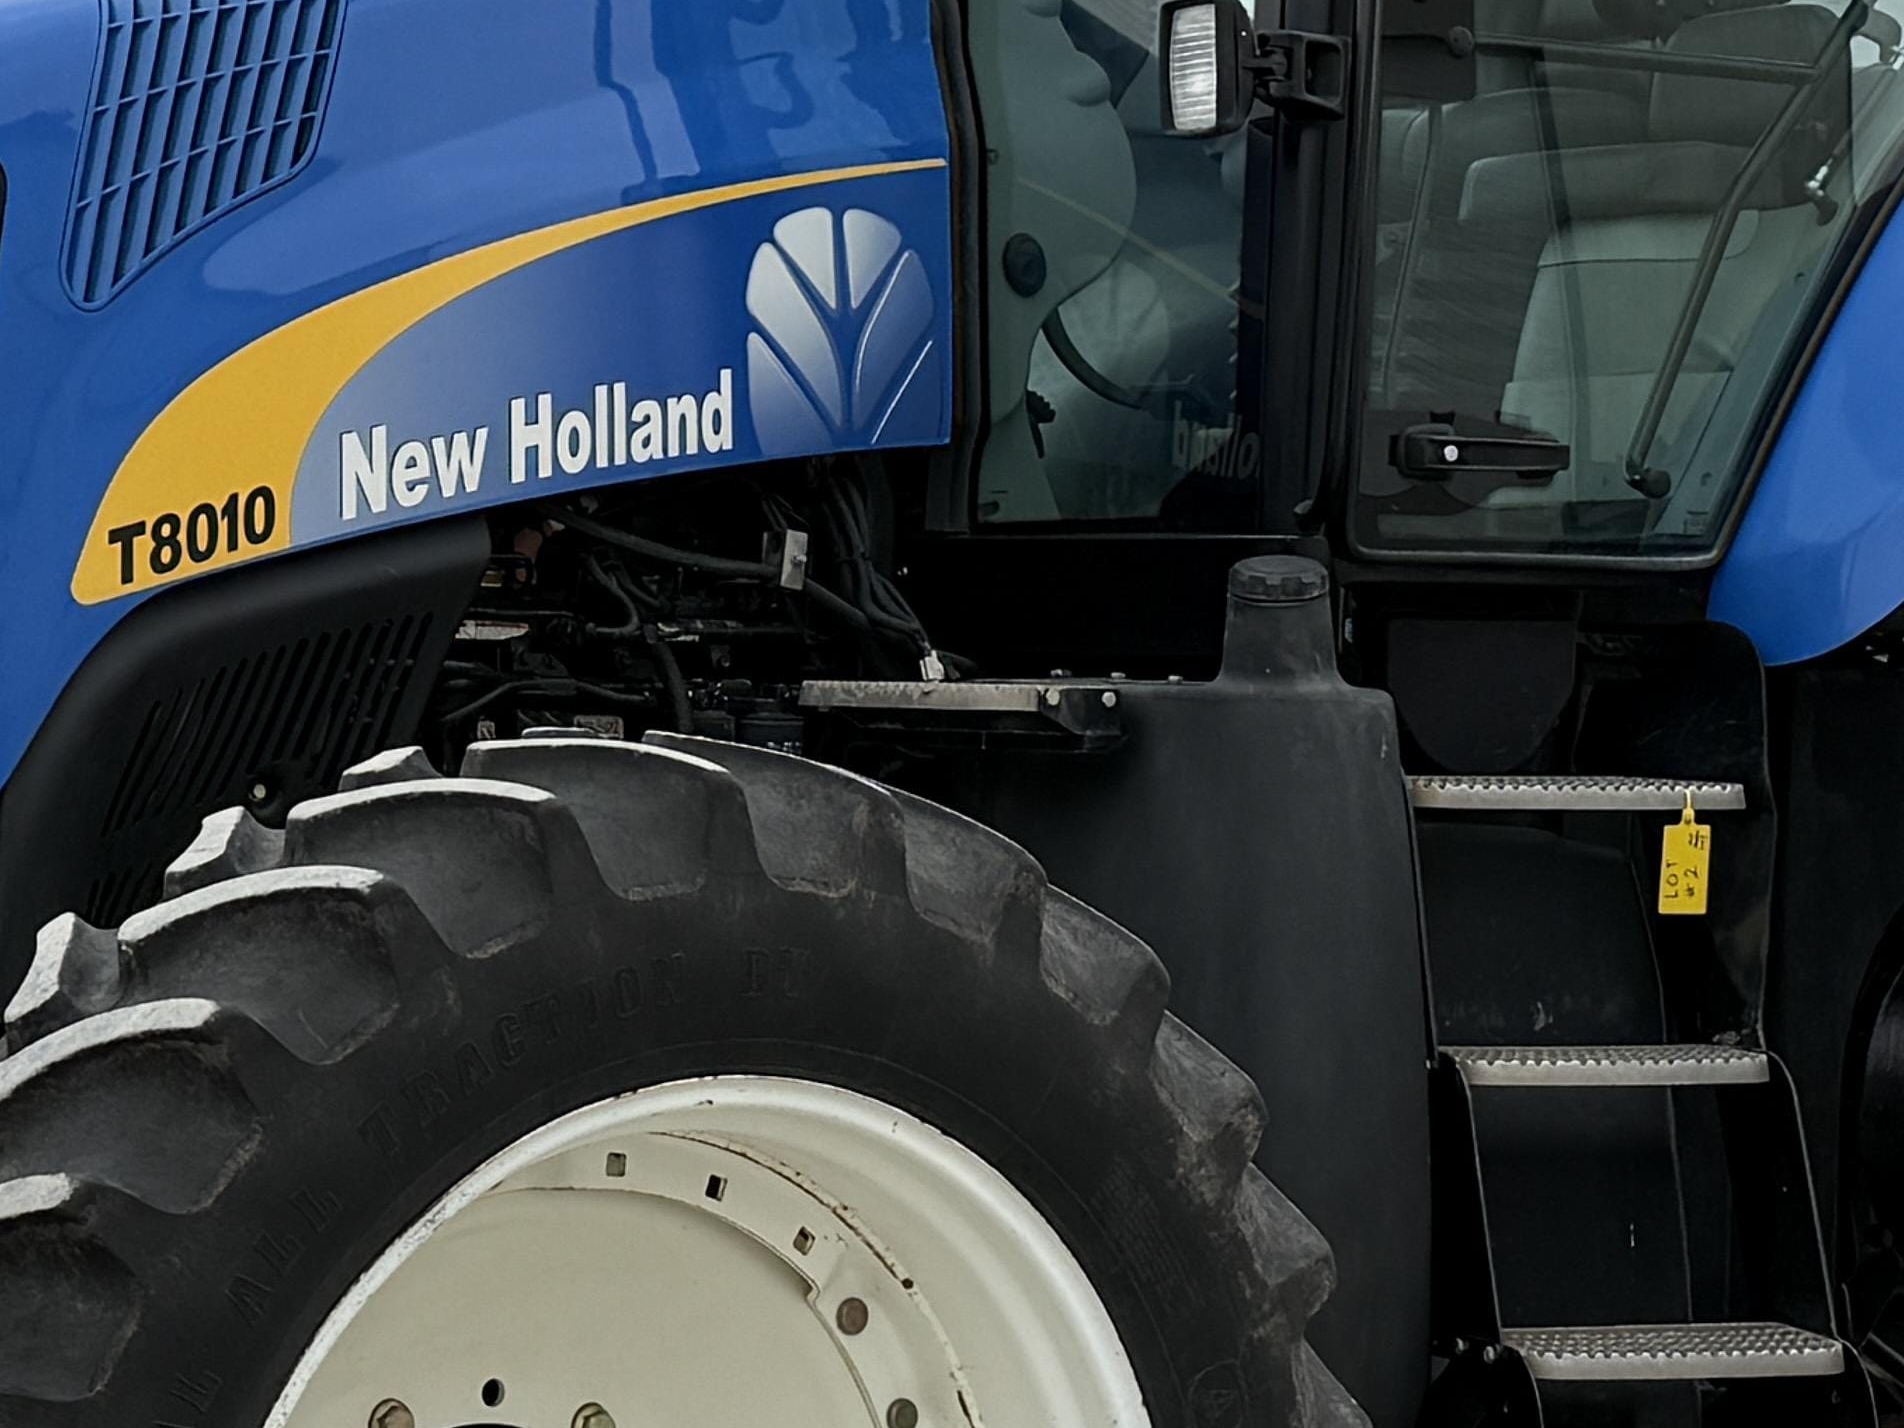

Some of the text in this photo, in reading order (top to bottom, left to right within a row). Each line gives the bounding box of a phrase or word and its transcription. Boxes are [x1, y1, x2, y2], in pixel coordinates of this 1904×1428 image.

[339, 368, 734, 521] New Holland
[108, 485, 276, 586] T8010
[1663, 860, 1679, 899] LOT
[357, 951, 687, 1157] TRACTION
